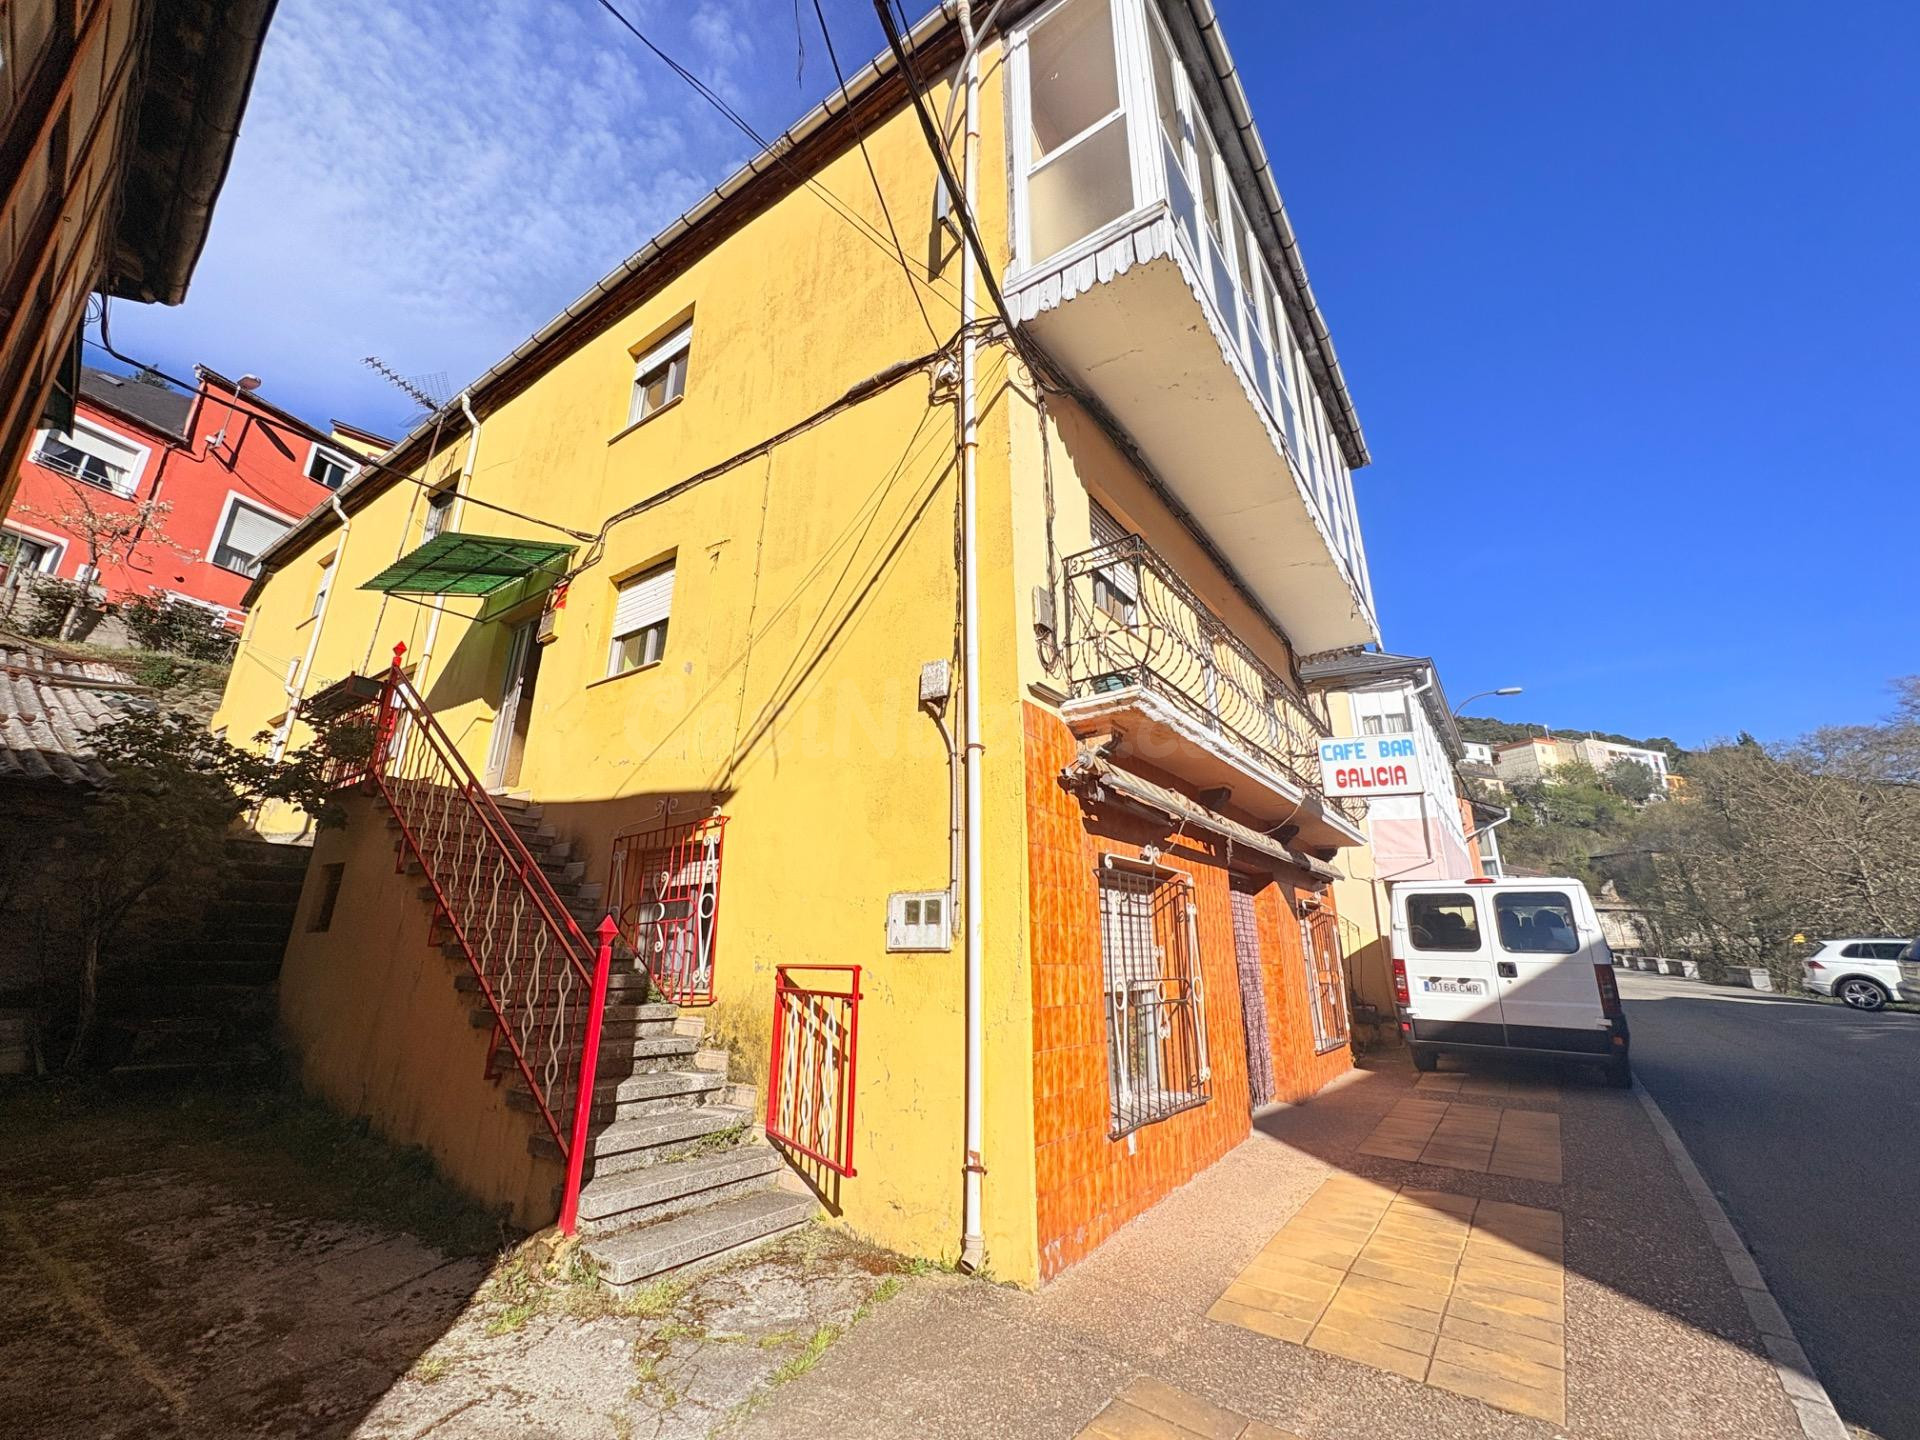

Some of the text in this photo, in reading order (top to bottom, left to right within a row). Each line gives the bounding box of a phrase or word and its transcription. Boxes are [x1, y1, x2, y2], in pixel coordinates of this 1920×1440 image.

[1322, 740, 1415, 761] CAFE BAR
[1336, 766, 1408, 788] GALICIA
